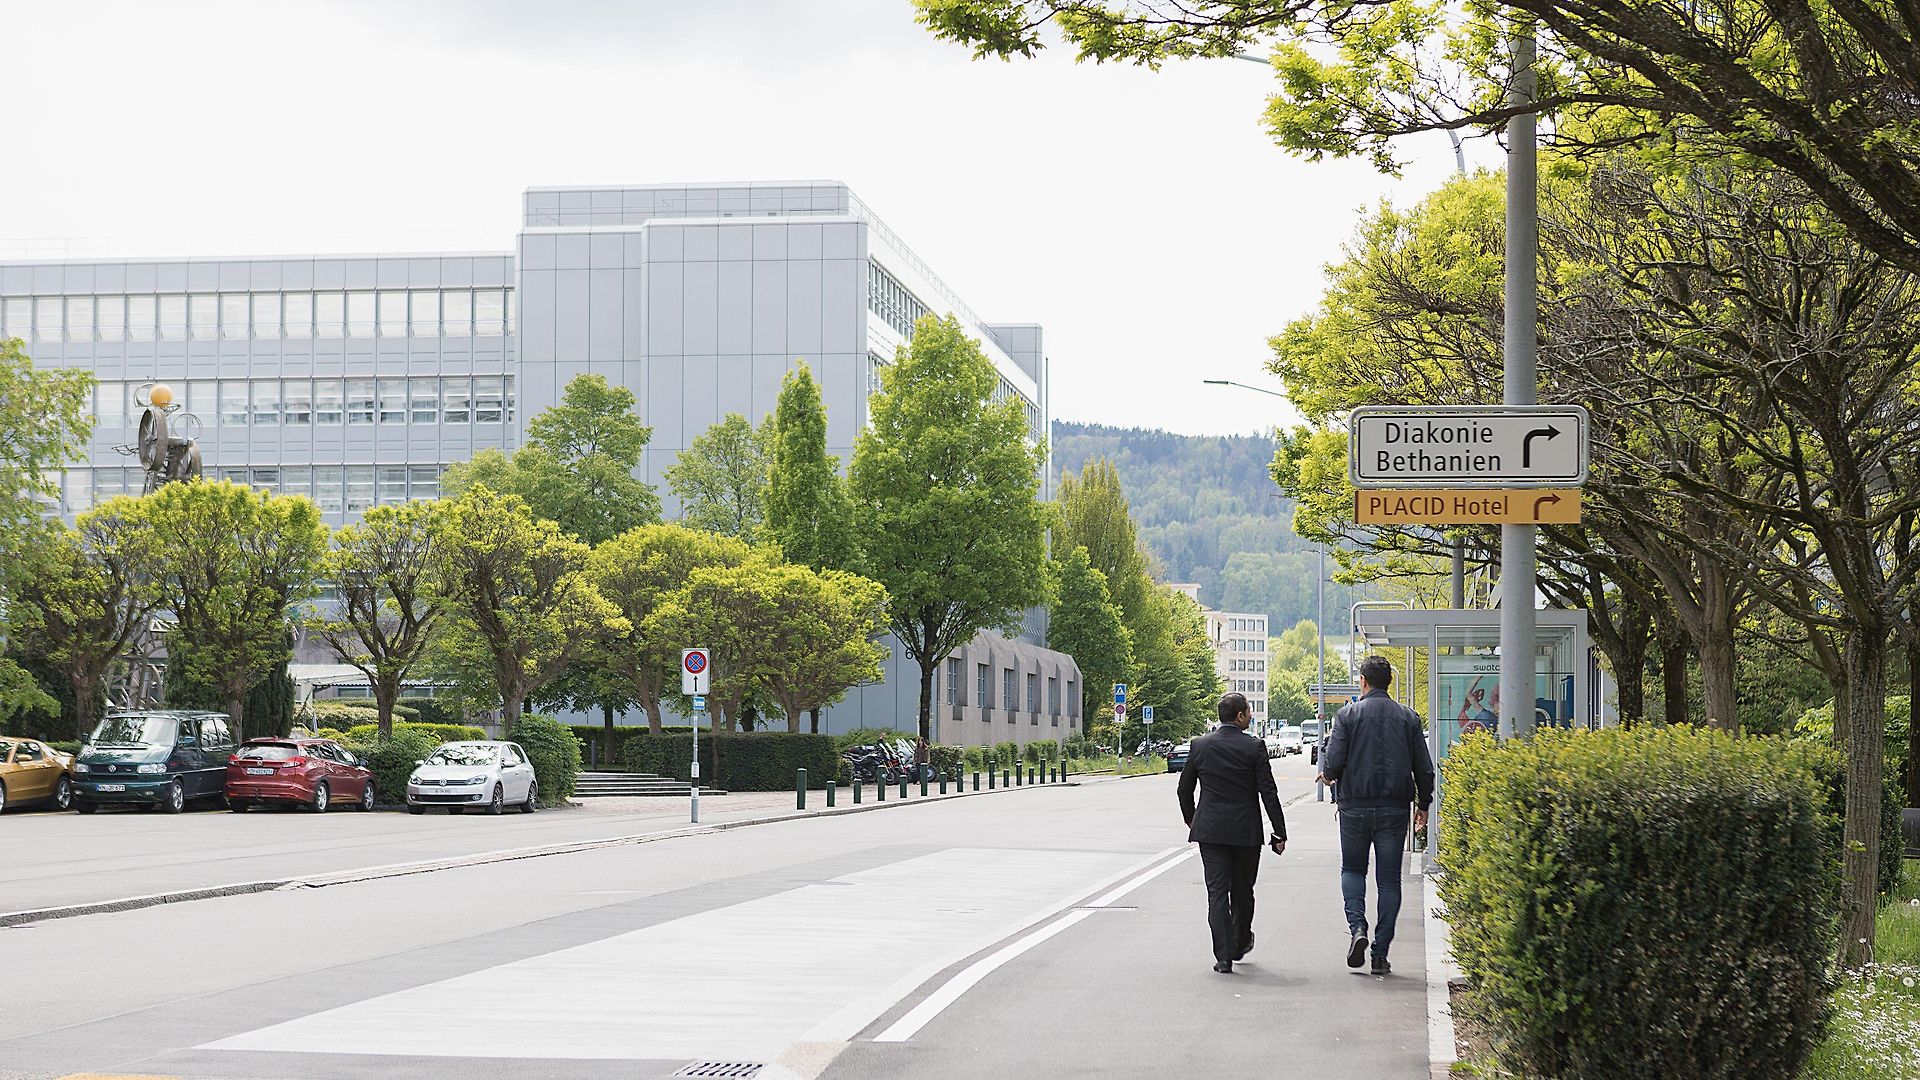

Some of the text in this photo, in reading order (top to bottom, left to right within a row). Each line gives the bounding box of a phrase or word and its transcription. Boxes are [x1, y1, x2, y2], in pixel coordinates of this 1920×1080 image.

[1385, 421, 1493, 444] Diakonie
[1377, 449, 1501, 472] Bethanien
[1370, 496, 1508, 516] PLACID Hotel
[1473, 664, 1500, 672] swatc
